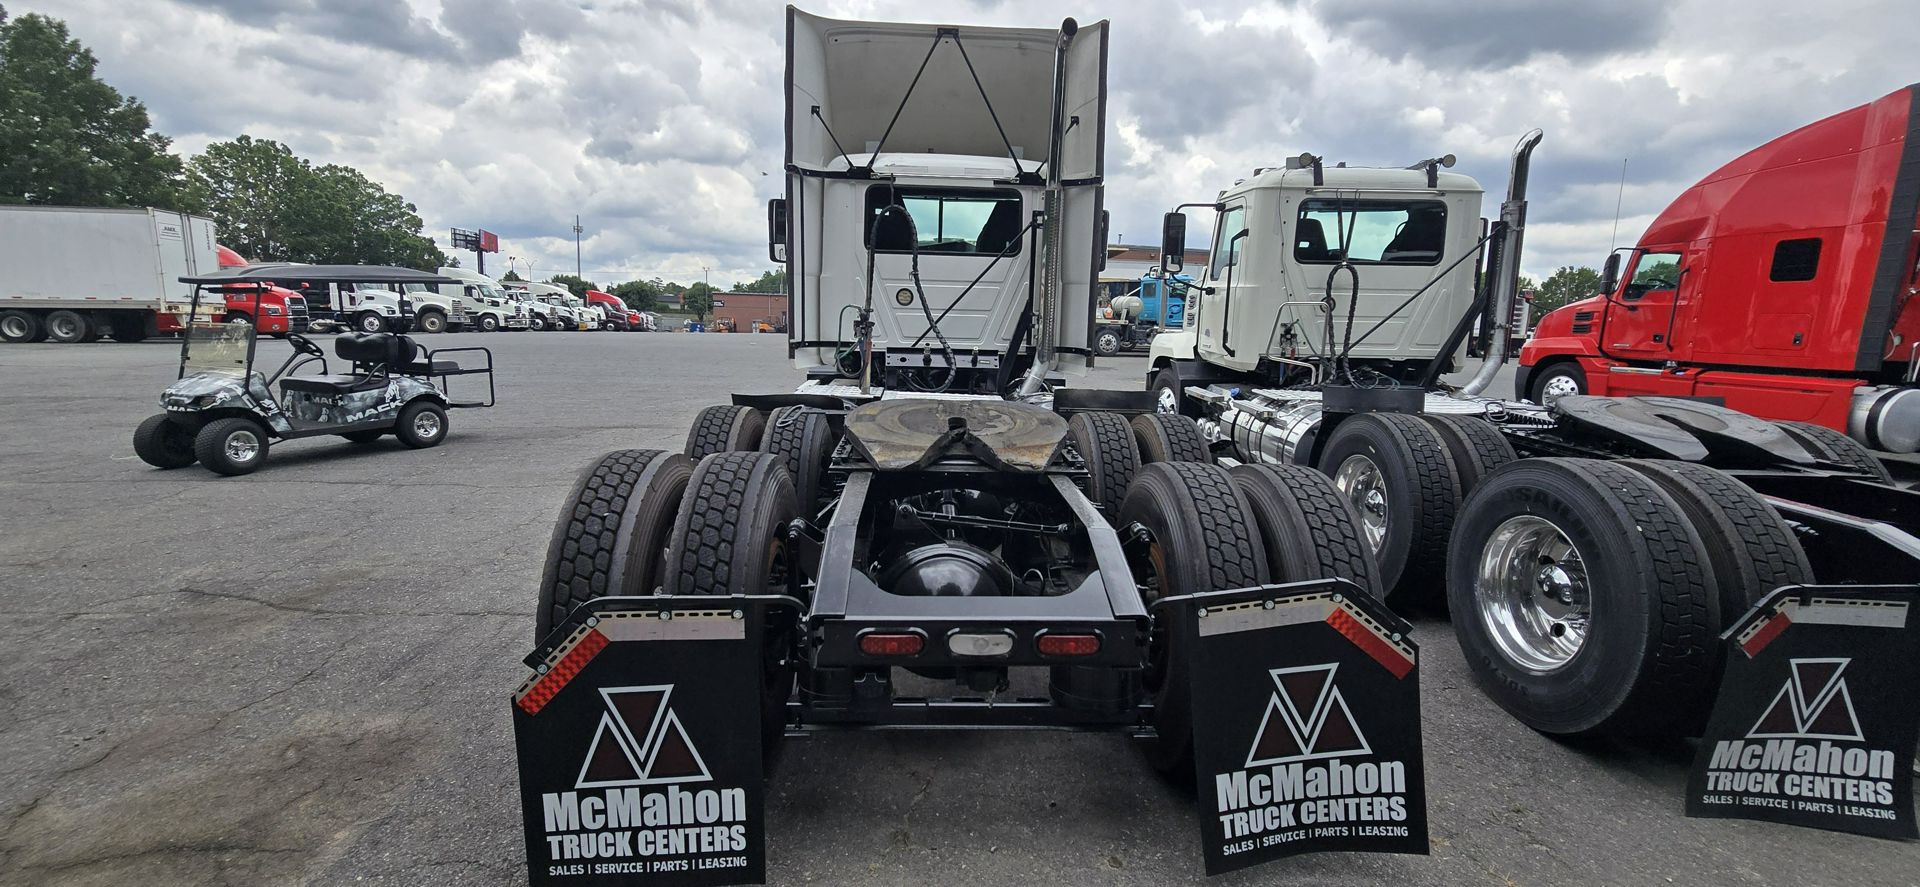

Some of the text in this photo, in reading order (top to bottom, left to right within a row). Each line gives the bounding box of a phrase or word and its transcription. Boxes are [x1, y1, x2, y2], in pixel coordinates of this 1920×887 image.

[346, 399, 404, 423] MACK
[1709, 740, 1895, 779] McMahon
[1215, 759, 1406, 812] McMahon
[1707, 771, 1893, 805] TRUCK CENTERS
[542, 786, 746, 832] McMahon
[1220, 796, 1406, 839] TRUCK CENTERS
[1703, 796, 1896, 820] SALES SERVICE PARTS LEASING
[547, 825, 746, 860] TRUCK CENTERS
[1223, 826, 1408, 855] SALES SERVICE PARTS LEASING
[549, 857, 747, 876] SALES SERVICE PARTS LEASING
